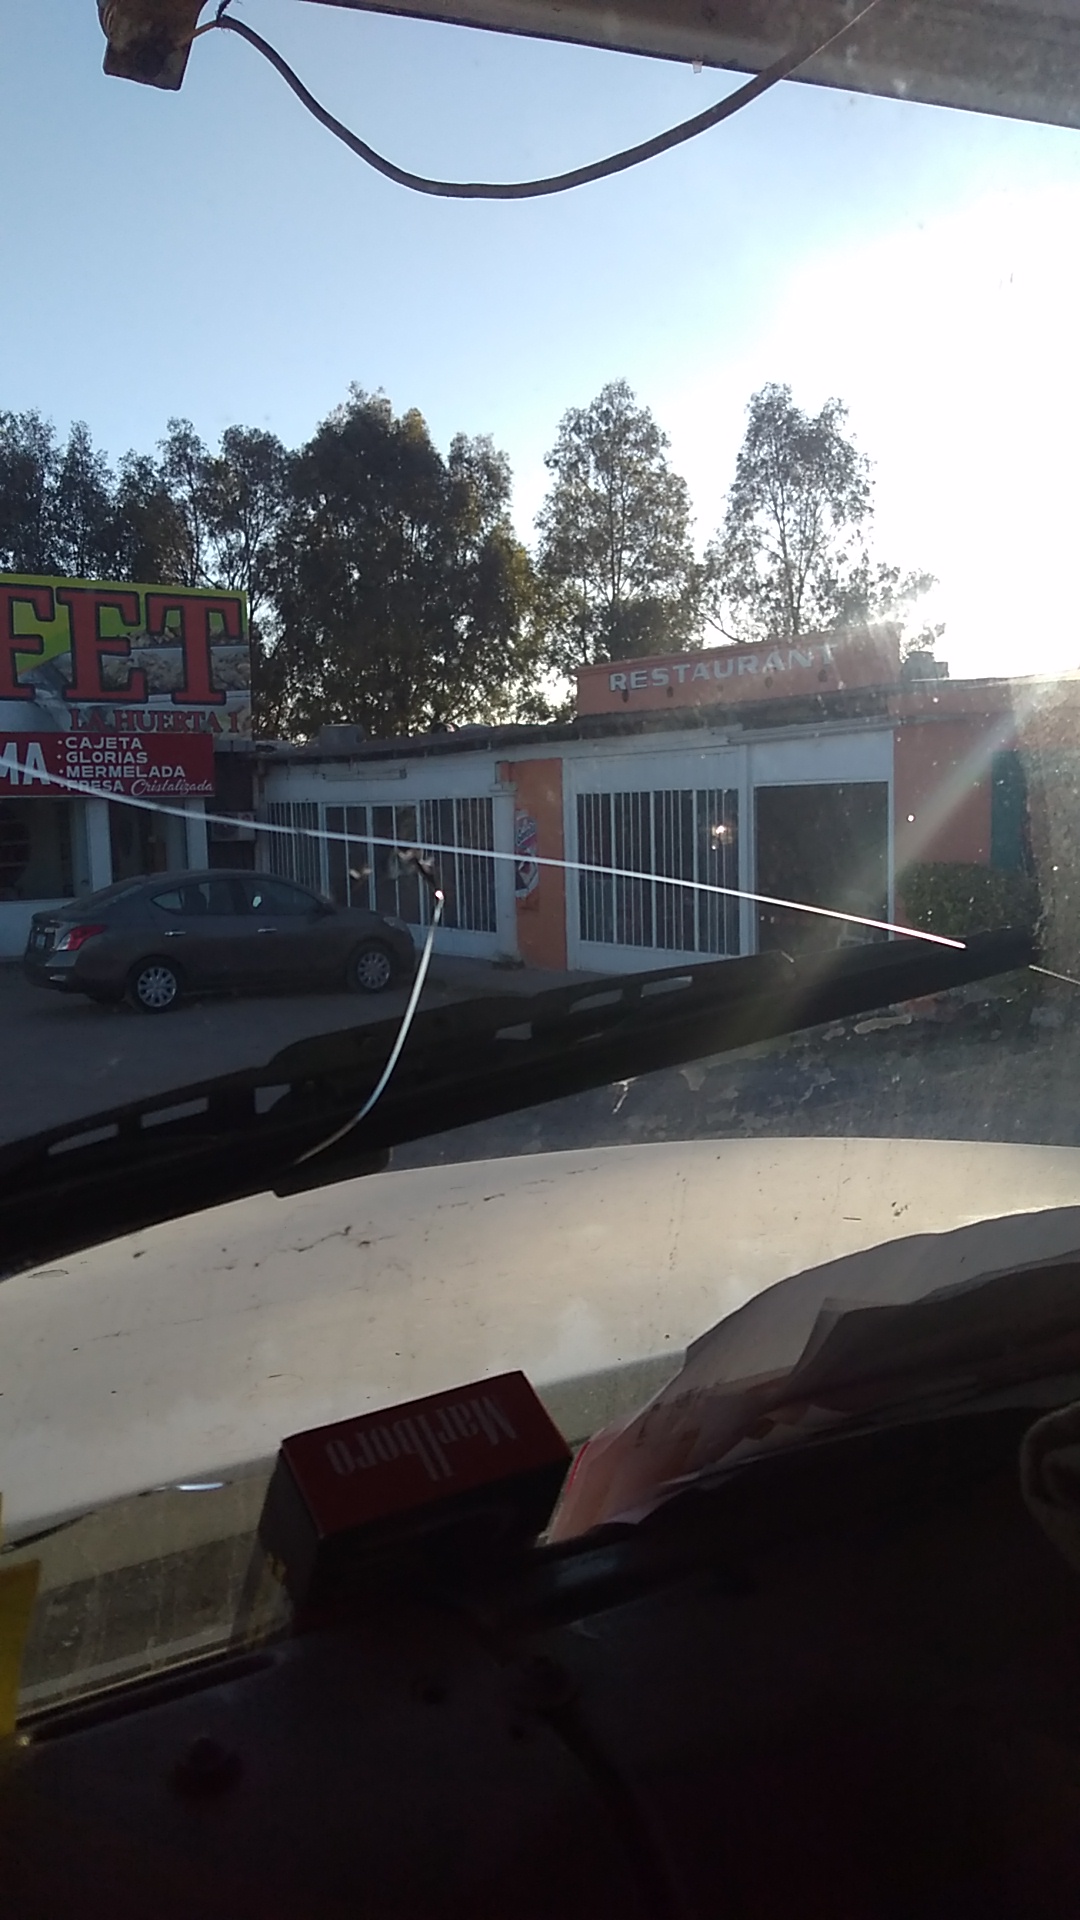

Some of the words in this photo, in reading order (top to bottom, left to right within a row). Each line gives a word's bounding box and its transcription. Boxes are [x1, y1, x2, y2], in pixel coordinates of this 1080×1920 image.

[609, 643, 837, 692] RESTAURANT
[70, 709, 106, 732] LA
[113, 710, 223, 733] HUERTA
[65, 737, 143, 750] CAJETA
[66, 751, 148, 764] GLORIAS
[66, 765, 185, 778] MERMELADA
[131, 778, 214, 796] Cristalizada
[325, 1396, 517, 1482] Marlboro
